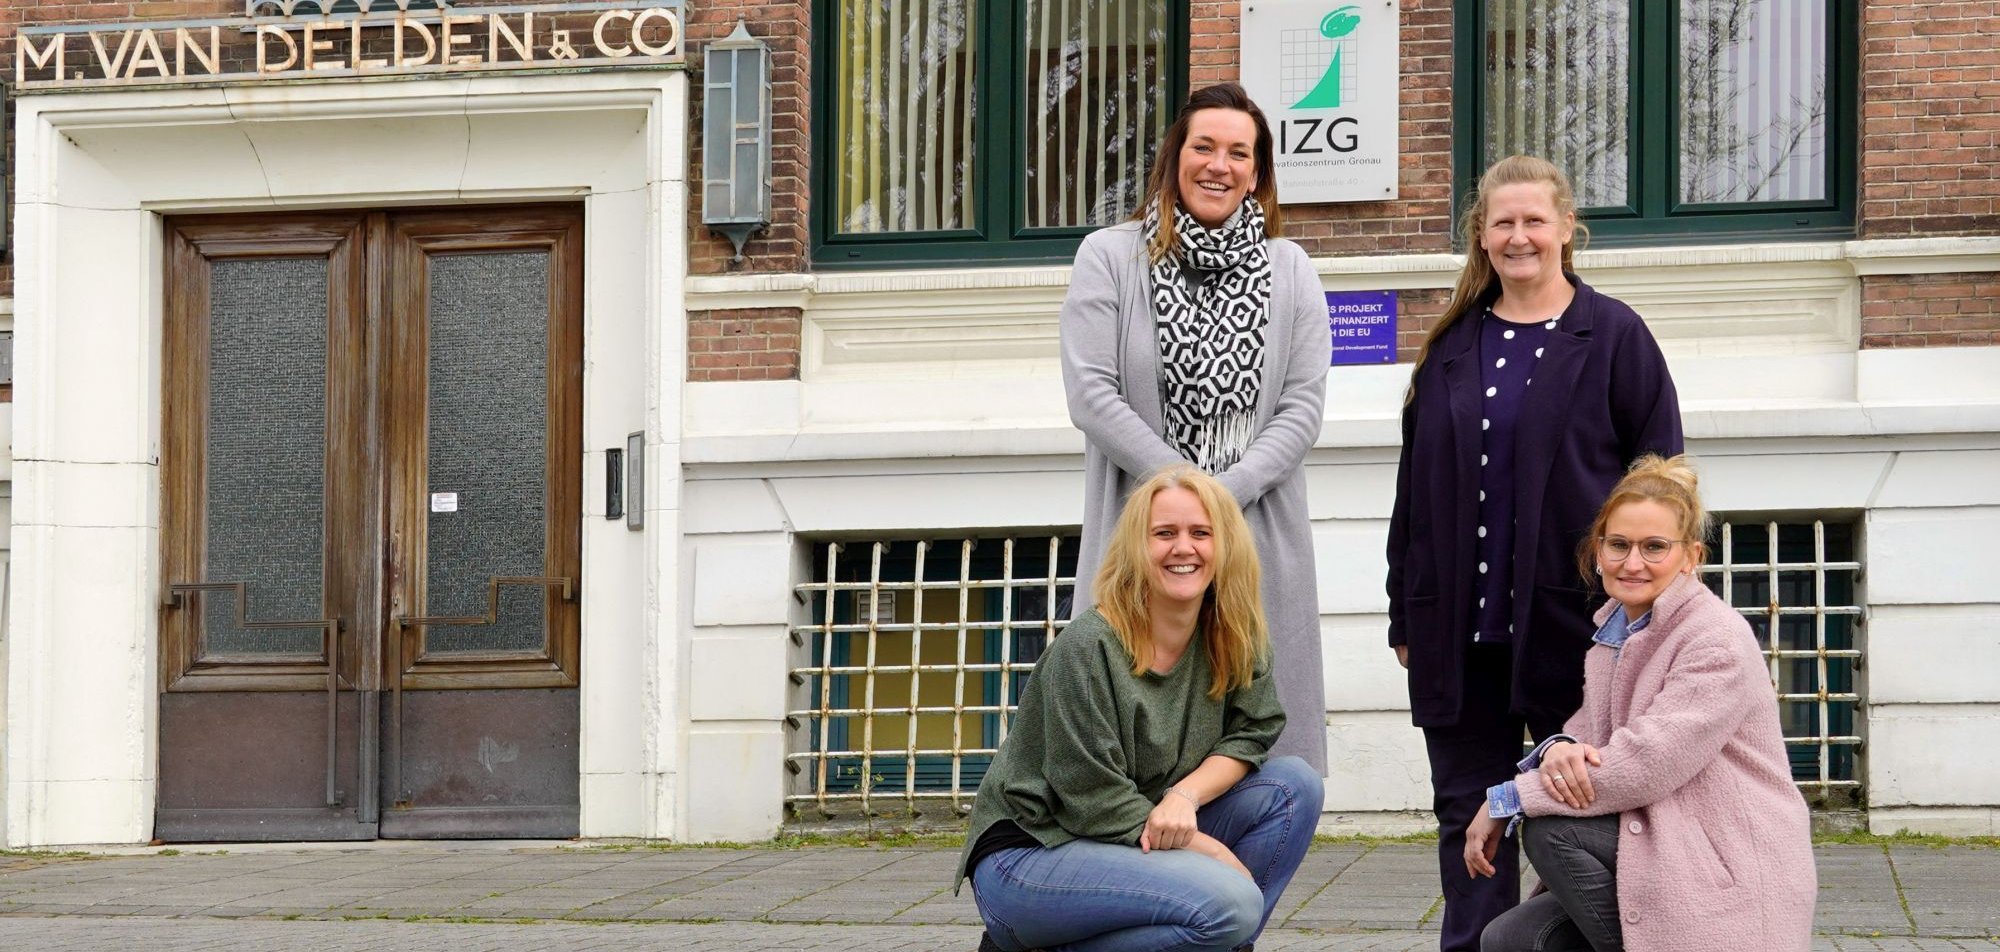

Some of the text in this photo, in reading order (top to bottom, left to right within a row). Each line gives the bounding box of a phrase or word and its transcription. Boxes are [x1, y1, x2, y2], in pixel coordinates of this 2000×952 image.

[89, 26, 220, 80] VAN
[257, 12, 533, 73] DELDEN
[548, 29, 579, 60] &
[593, 8, 680, 58] CO
[1280, 117, 1358, 154] IZG
[1349, 157, 1381, 166] Gronau
[1338, 304, 1383, 313] PROJEKT
[1339, 329, 1355, 337] DIE
[1357, 328, 1370, 336] EU
